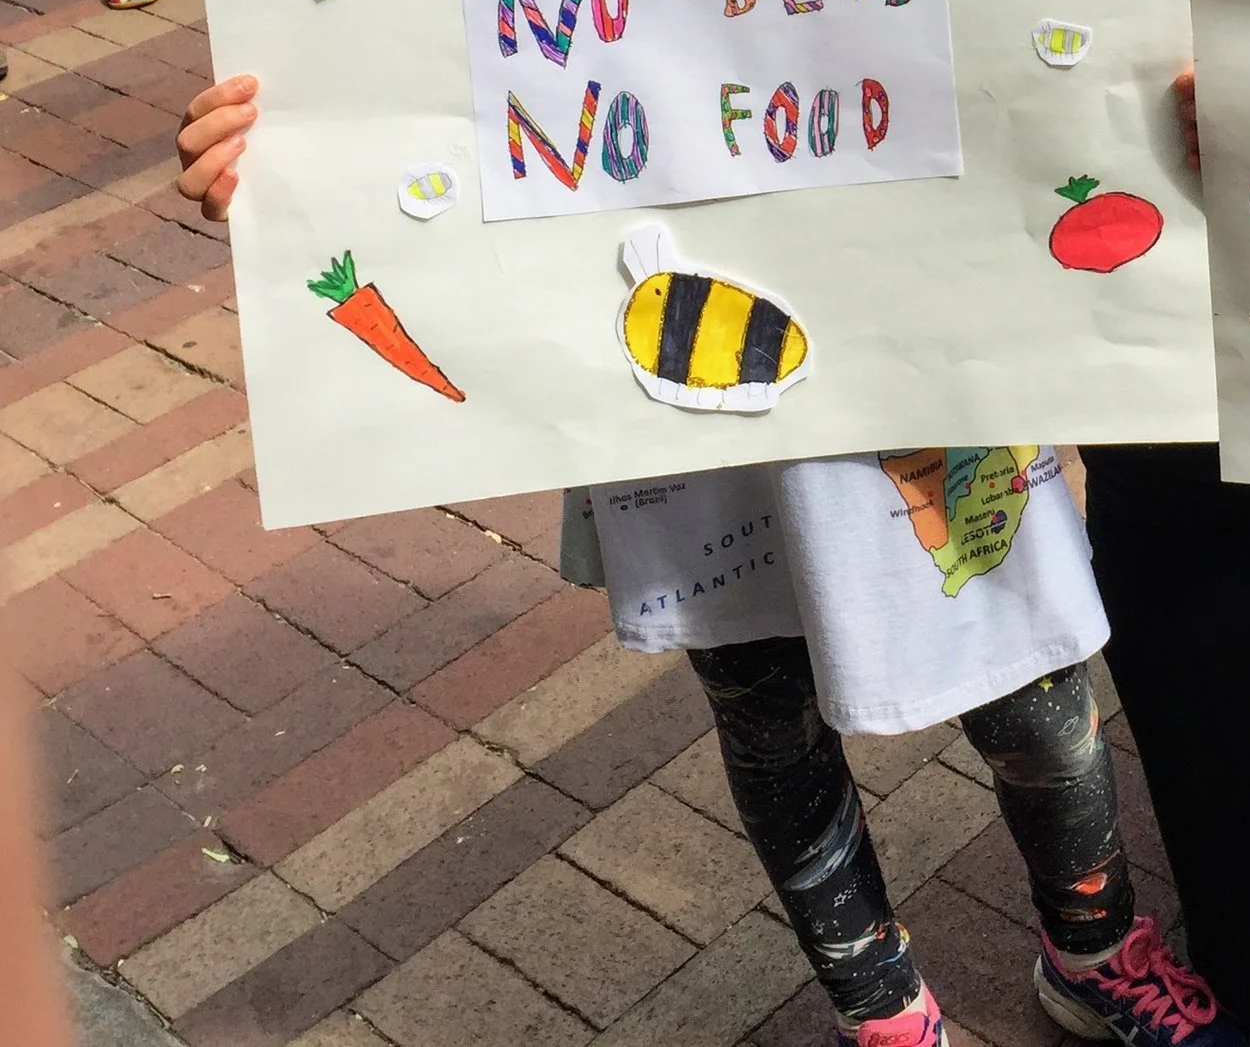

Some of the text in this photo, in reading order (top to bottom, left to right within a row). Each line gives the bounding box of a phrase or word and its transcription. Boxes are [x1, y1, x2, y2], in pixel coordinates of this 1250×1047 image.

[507, 78, 890, 191] NO FOOD
[900, 459, 943, 484] NAMIBIA
[965, 509, 995, 525] Maseru
[969, 539, 1008, 560] AFRICA
[639, 552, 775, 616] ATLANTIC
